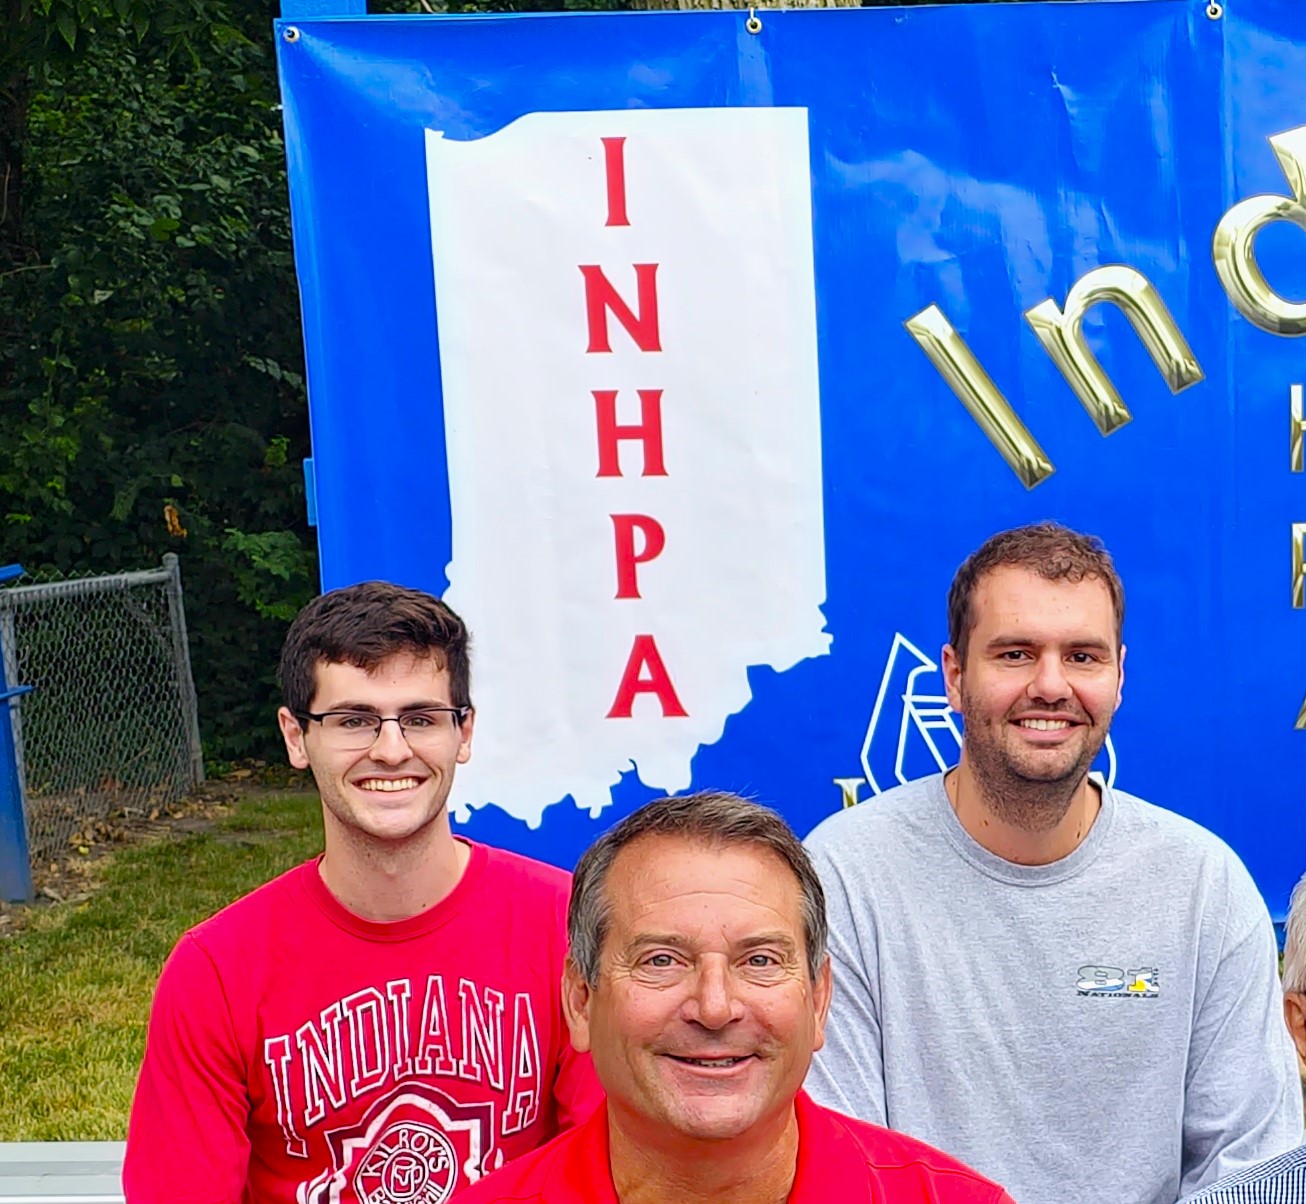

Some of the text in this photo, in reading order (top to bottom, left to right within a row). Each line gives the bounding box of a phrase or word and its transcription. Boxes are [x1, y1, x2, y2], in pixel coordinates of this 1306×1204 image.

[578, 136, 690, 719] INHPA
[264, 975, 541, 1158] INDIANA
[361, 1128, 450, 1177] KILROY'S
